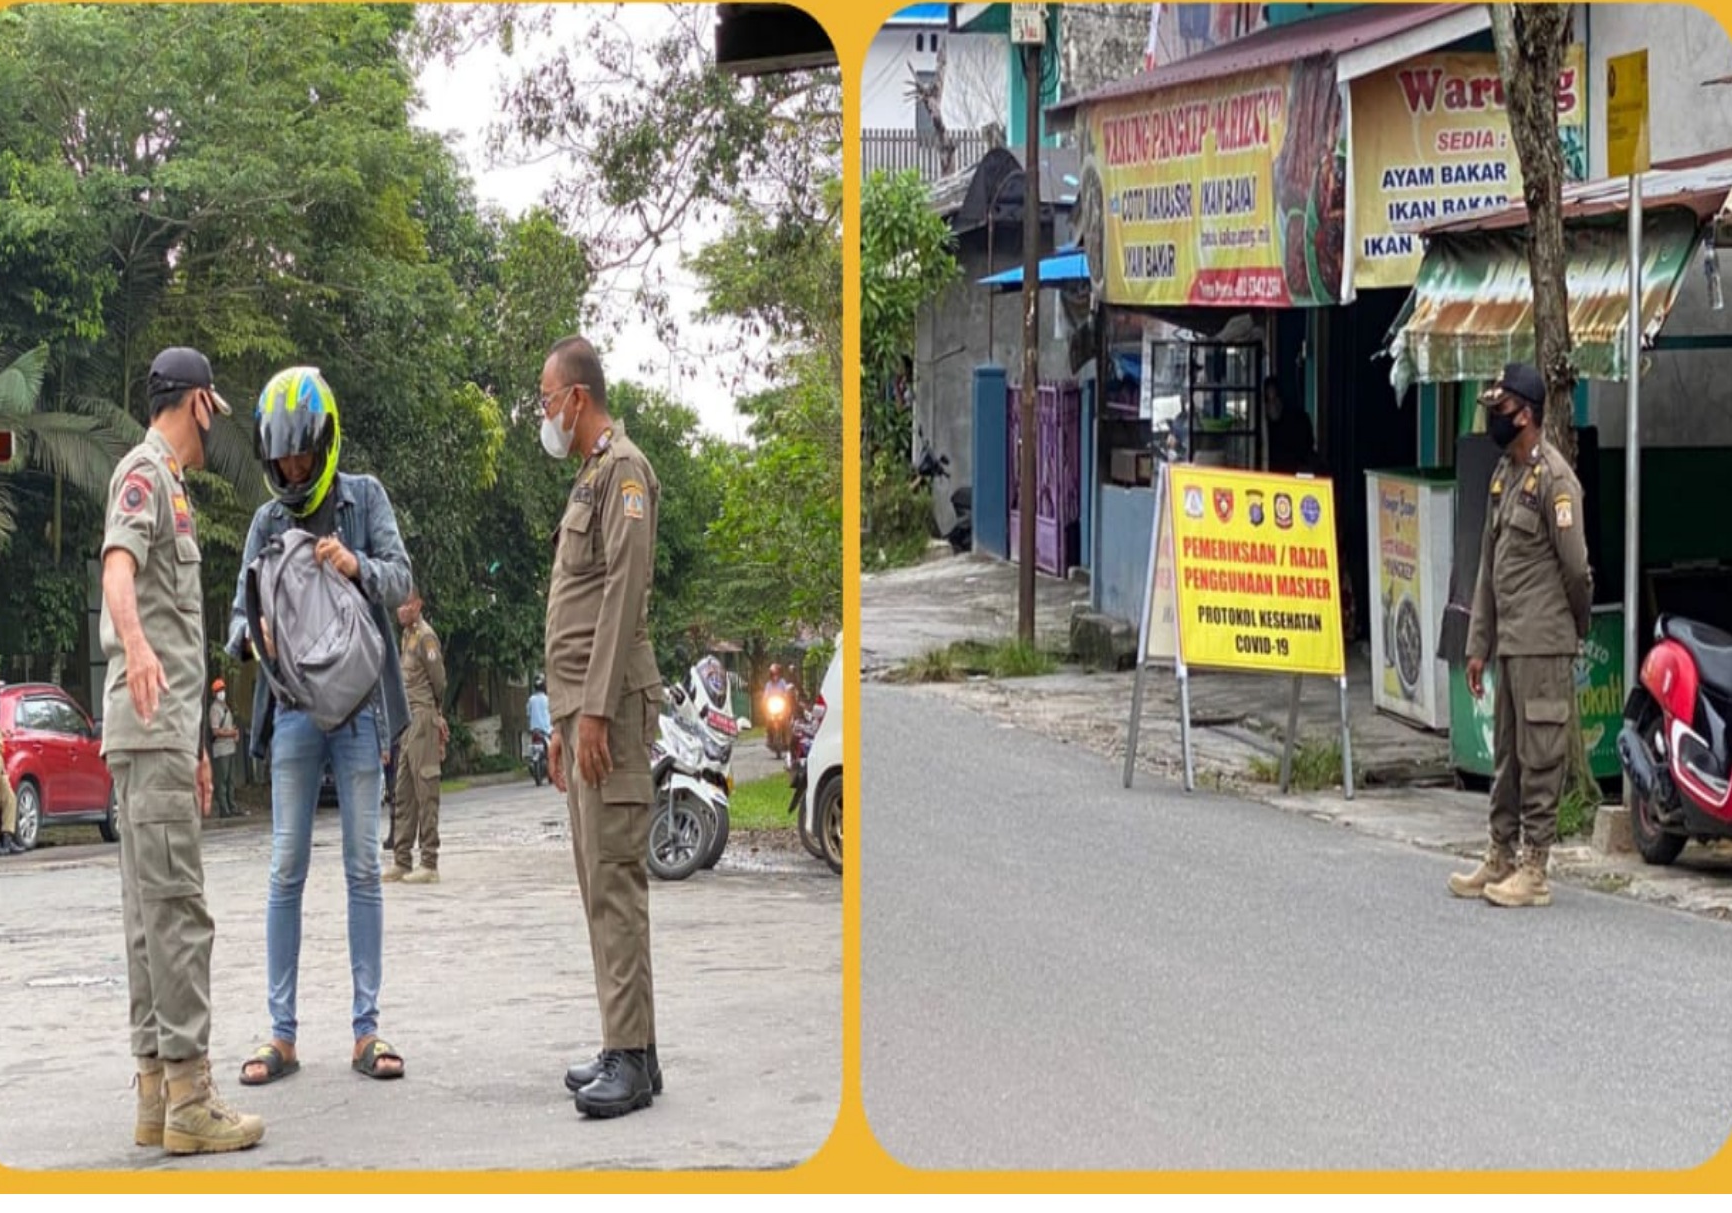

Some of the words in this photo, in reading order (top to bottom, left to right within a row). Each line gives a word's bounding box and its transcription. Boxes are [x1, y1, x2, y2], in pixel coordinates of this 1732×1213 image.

[1437, 131, 1494, 152] SEDIA
[1382, 167, 1434, 188] AYAM
[1441, 162, 1507, 184] BAKAR
[1388, 200, 1435, 221] IKAN
[1364, 236, 1411, 256] IKAN
[1183, 536, 1276, 565] PEMERIKSAAN
[1289, 547, 1329, 569] RAZIA
[1184, 567, 1273, 596] PENGGUNAAN
[1276, 575, 1331, 600] MASKER
[1198, 605, 1257, 627] PROTOKOL
[1259, 610, 1321, 632] KESEHATAN
[1235, 635, 1289, 656] COVID-19
